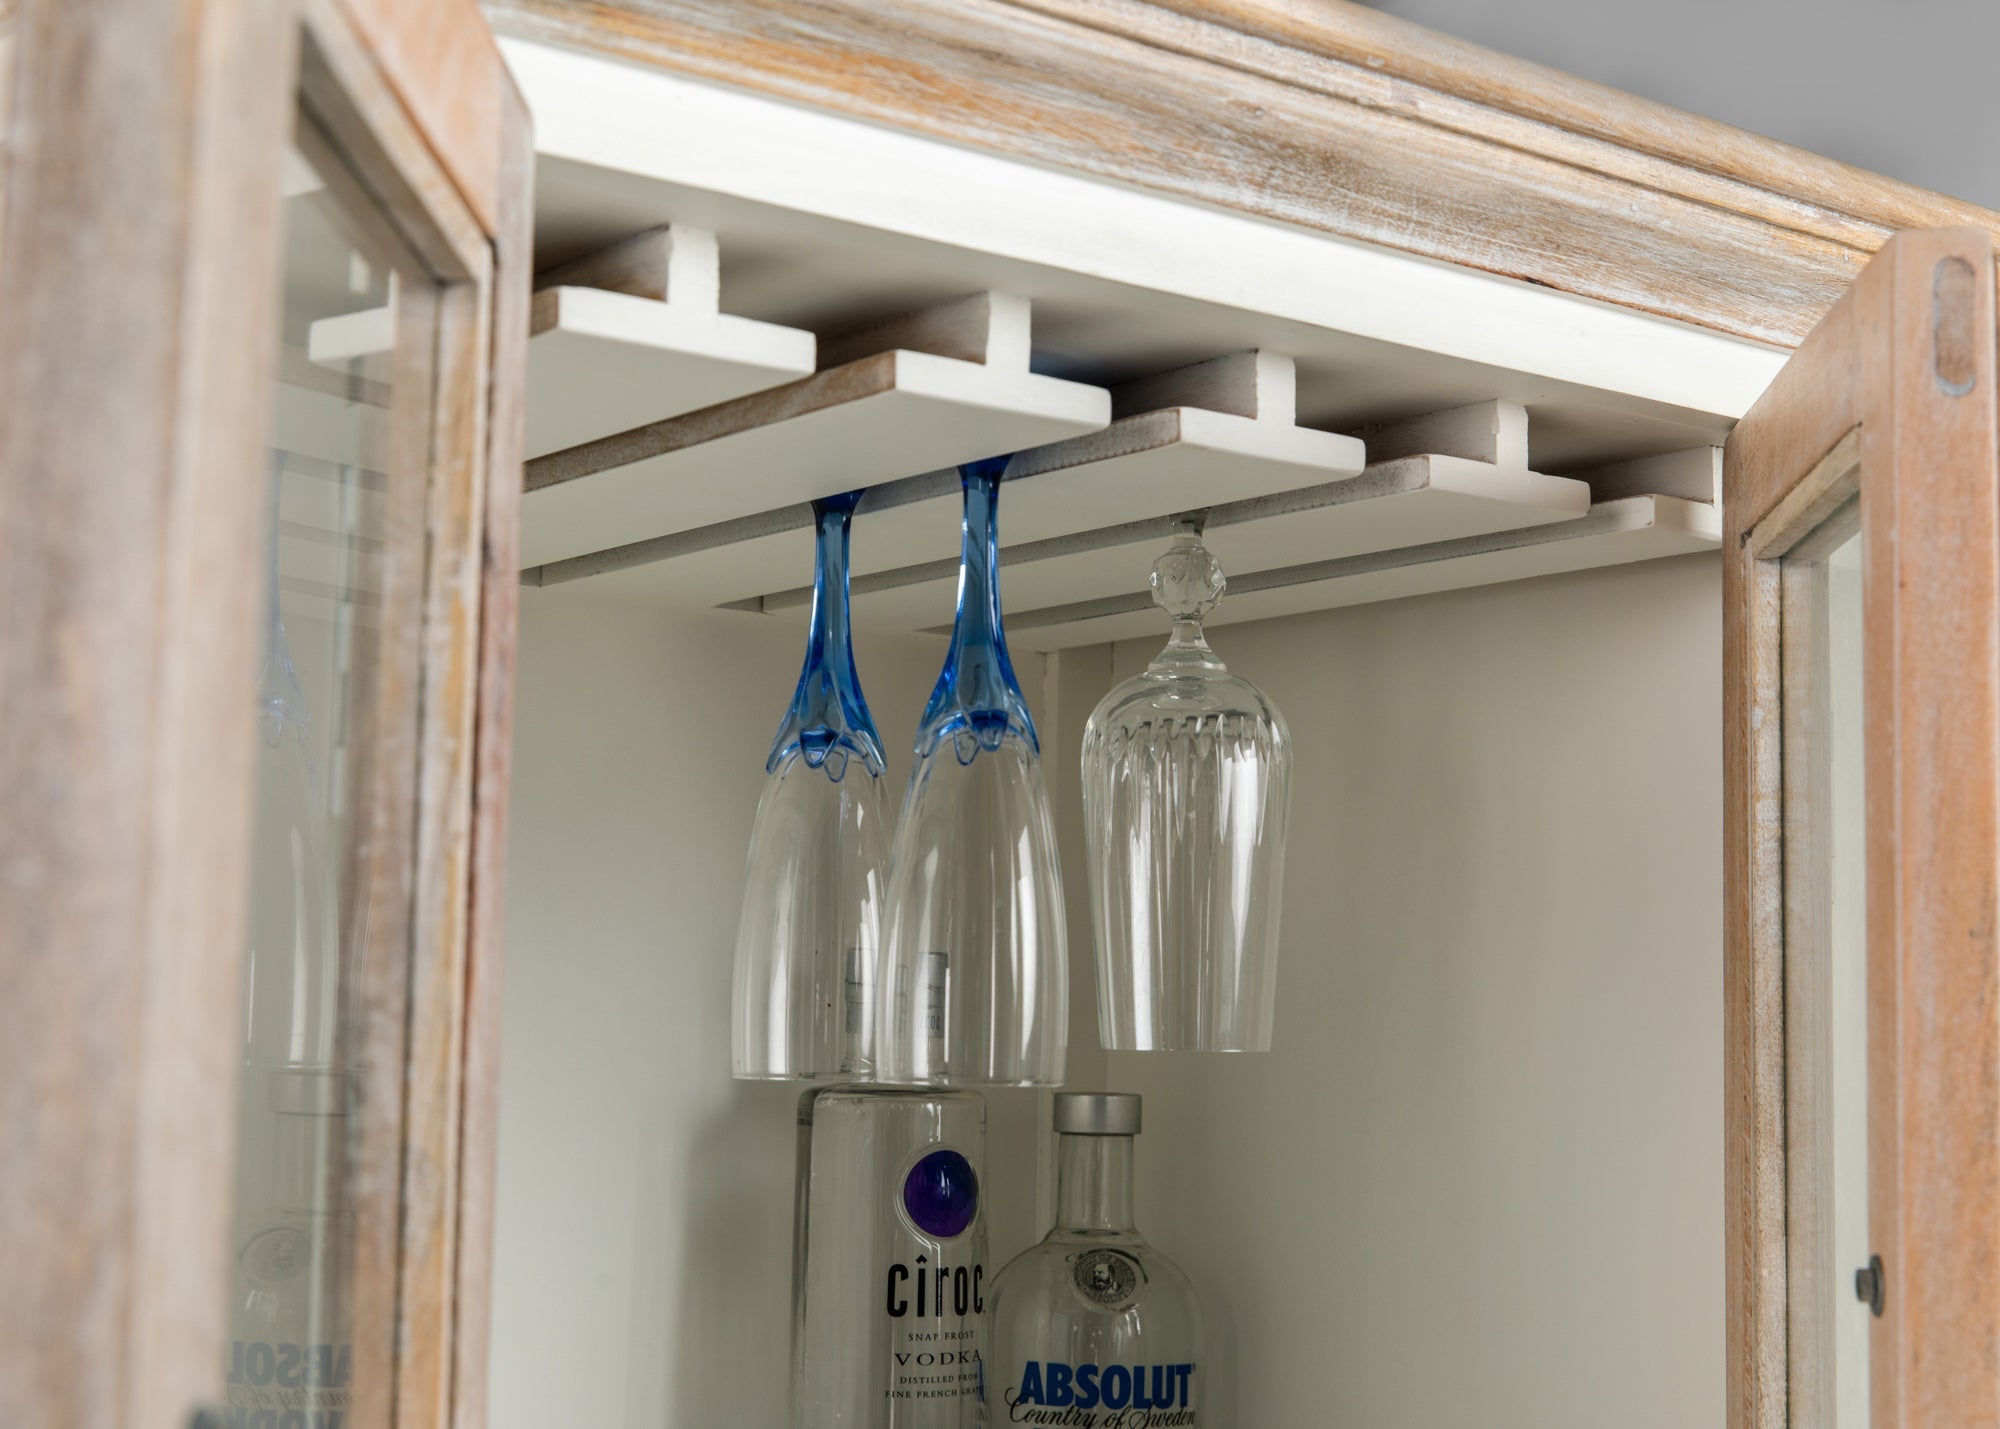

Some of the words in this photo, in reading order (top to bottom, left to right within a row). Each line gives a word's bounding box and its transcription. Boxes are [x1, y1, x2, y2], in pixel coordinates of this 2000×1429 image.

[907, 1332, 939, 1342] SNAP
[944, 1329, 974, 1341] FROST
[894, 1348, 981, 1367] VODKA
[899, 1375, 954, 1385] DISTILLED
[958, 1372, 979, 1383] FROM
[1017, 1360, 1192, 1410] ABSOLUT
[884, 1390, 911, 1399] FINE
[916, 1388, 957, 1399] FRENCH
[1004, 1386, 1097, 1428] Country
[1097, 1404, 1133, 1429] of
[1129, 1398, 1196, 1429] Sweden
